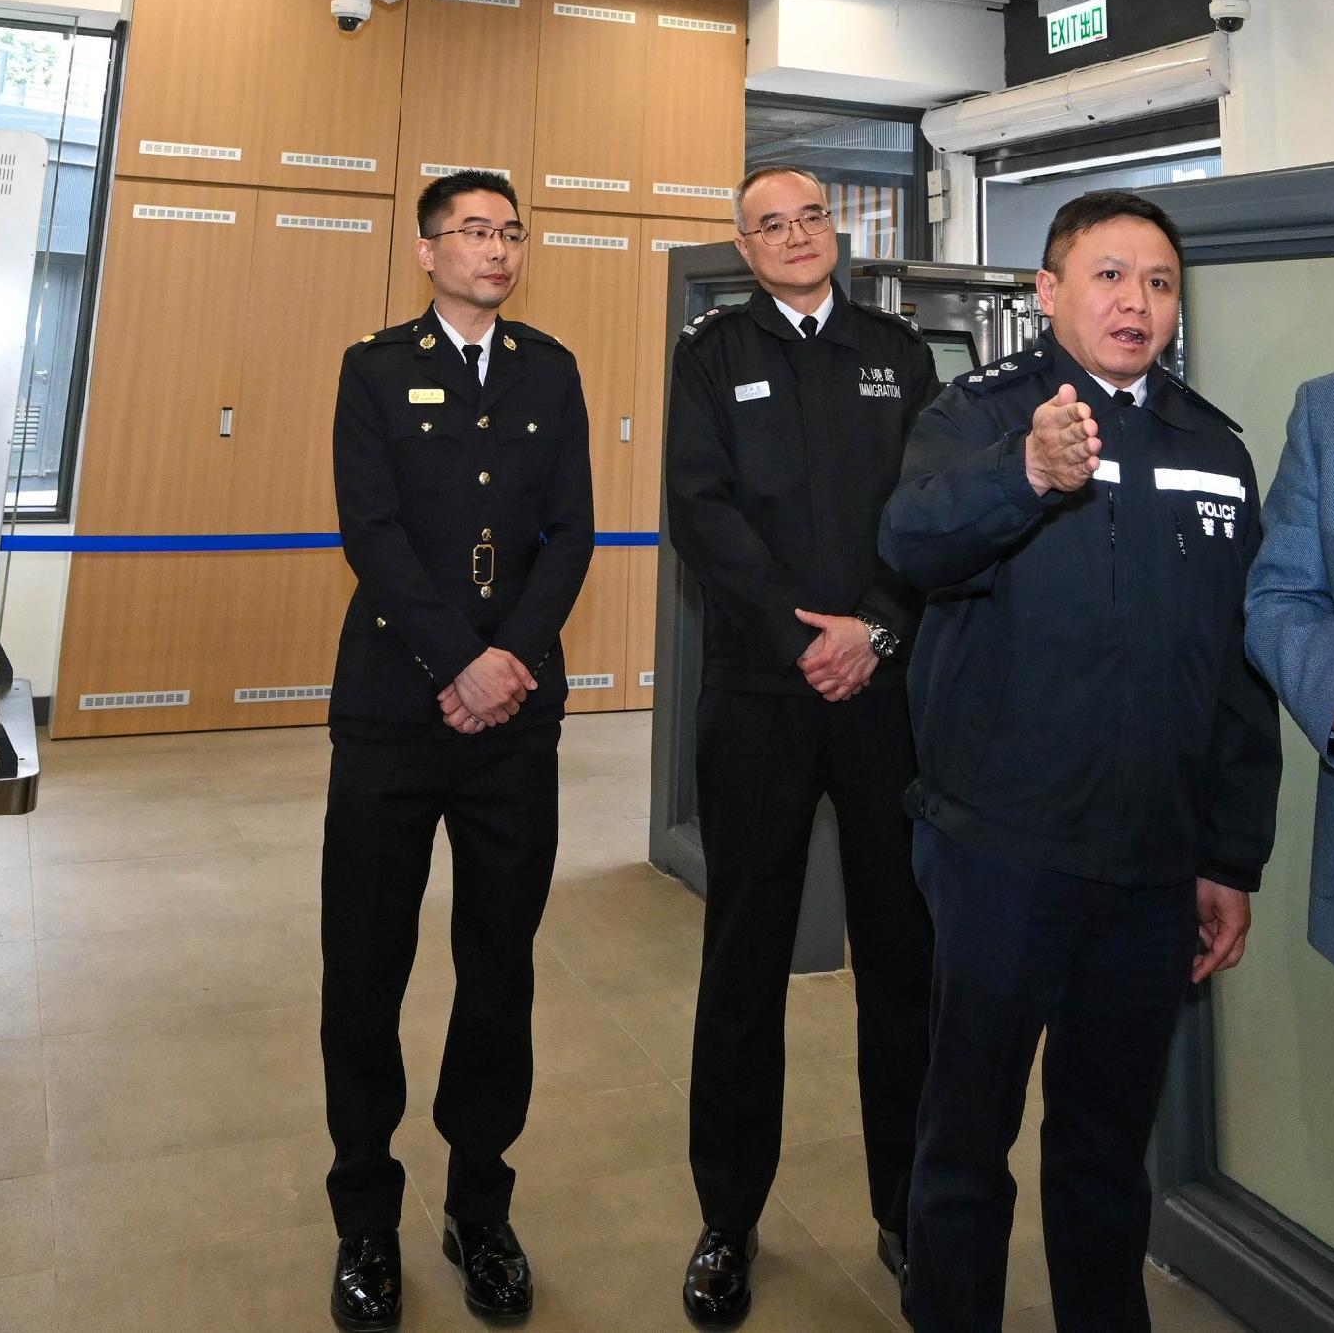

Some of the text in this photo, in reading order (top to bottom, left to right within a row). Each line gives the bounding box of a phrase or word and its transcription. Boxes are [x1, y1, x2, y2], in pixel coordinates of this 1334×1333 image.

[1050, 6, 1103, 49] EXIT 出口
[859, 367, 895, 382] 入境處
[859, 383, 901, 398] IMMIGRATION
[1197, 501, 1235, 520] POLICE
[1202, 518, 1234, 539] 警察
